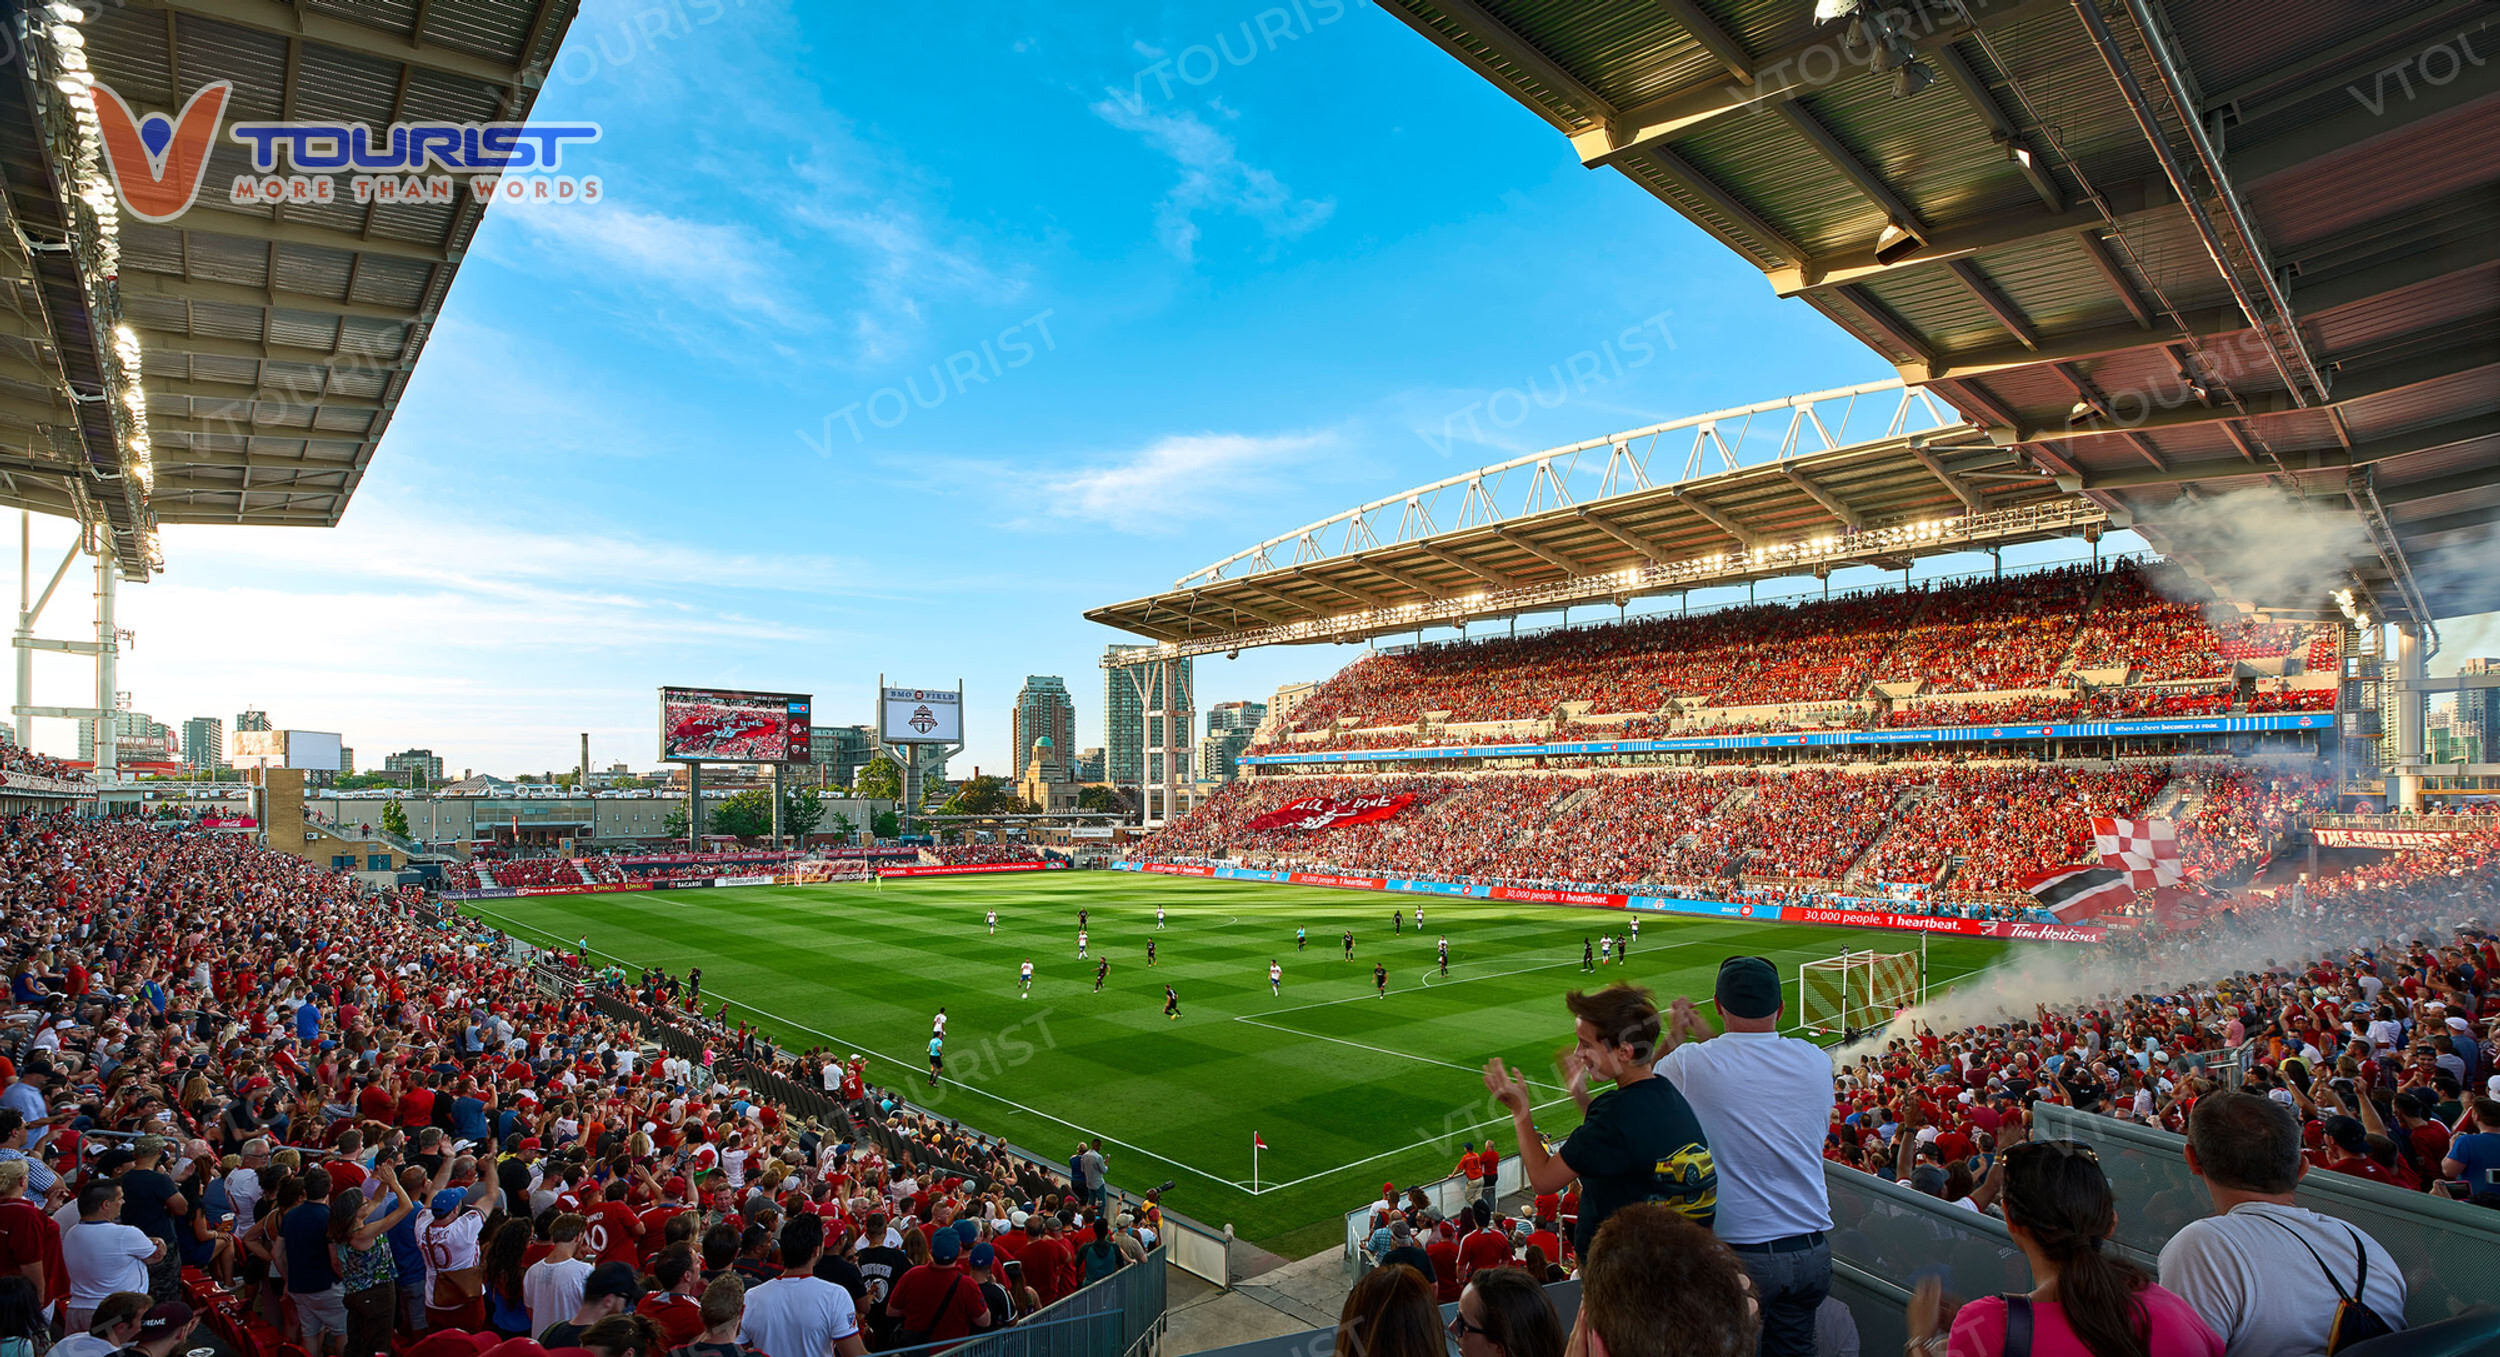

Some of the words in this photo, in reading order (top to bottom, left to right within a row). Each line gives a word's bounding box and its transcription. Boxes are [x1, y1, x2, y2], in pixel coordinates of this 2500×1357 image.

[1290, 798, 1324, 811] ALL
[2314, 829, 2348, 847] THE
[2350, 831, 2453, 847] FORTRESS
[593, 884, 617, 892] Unico
[1506, 889, 1530, 899] 30,000
[1530, 892, 1557, 901] people.
[1566, 893, 1609, 904] heartbeat.
[1804, 910, 1841, 922] 30,000
[1842, 914, 1882, 926] people.
[1887, 916, 1893, 924] 1
[1897, 915, 1962, 930] heartbeat.
[2010, 923, 2039, 938] Tim
[2038, 924, 2097, 942] Hortons
